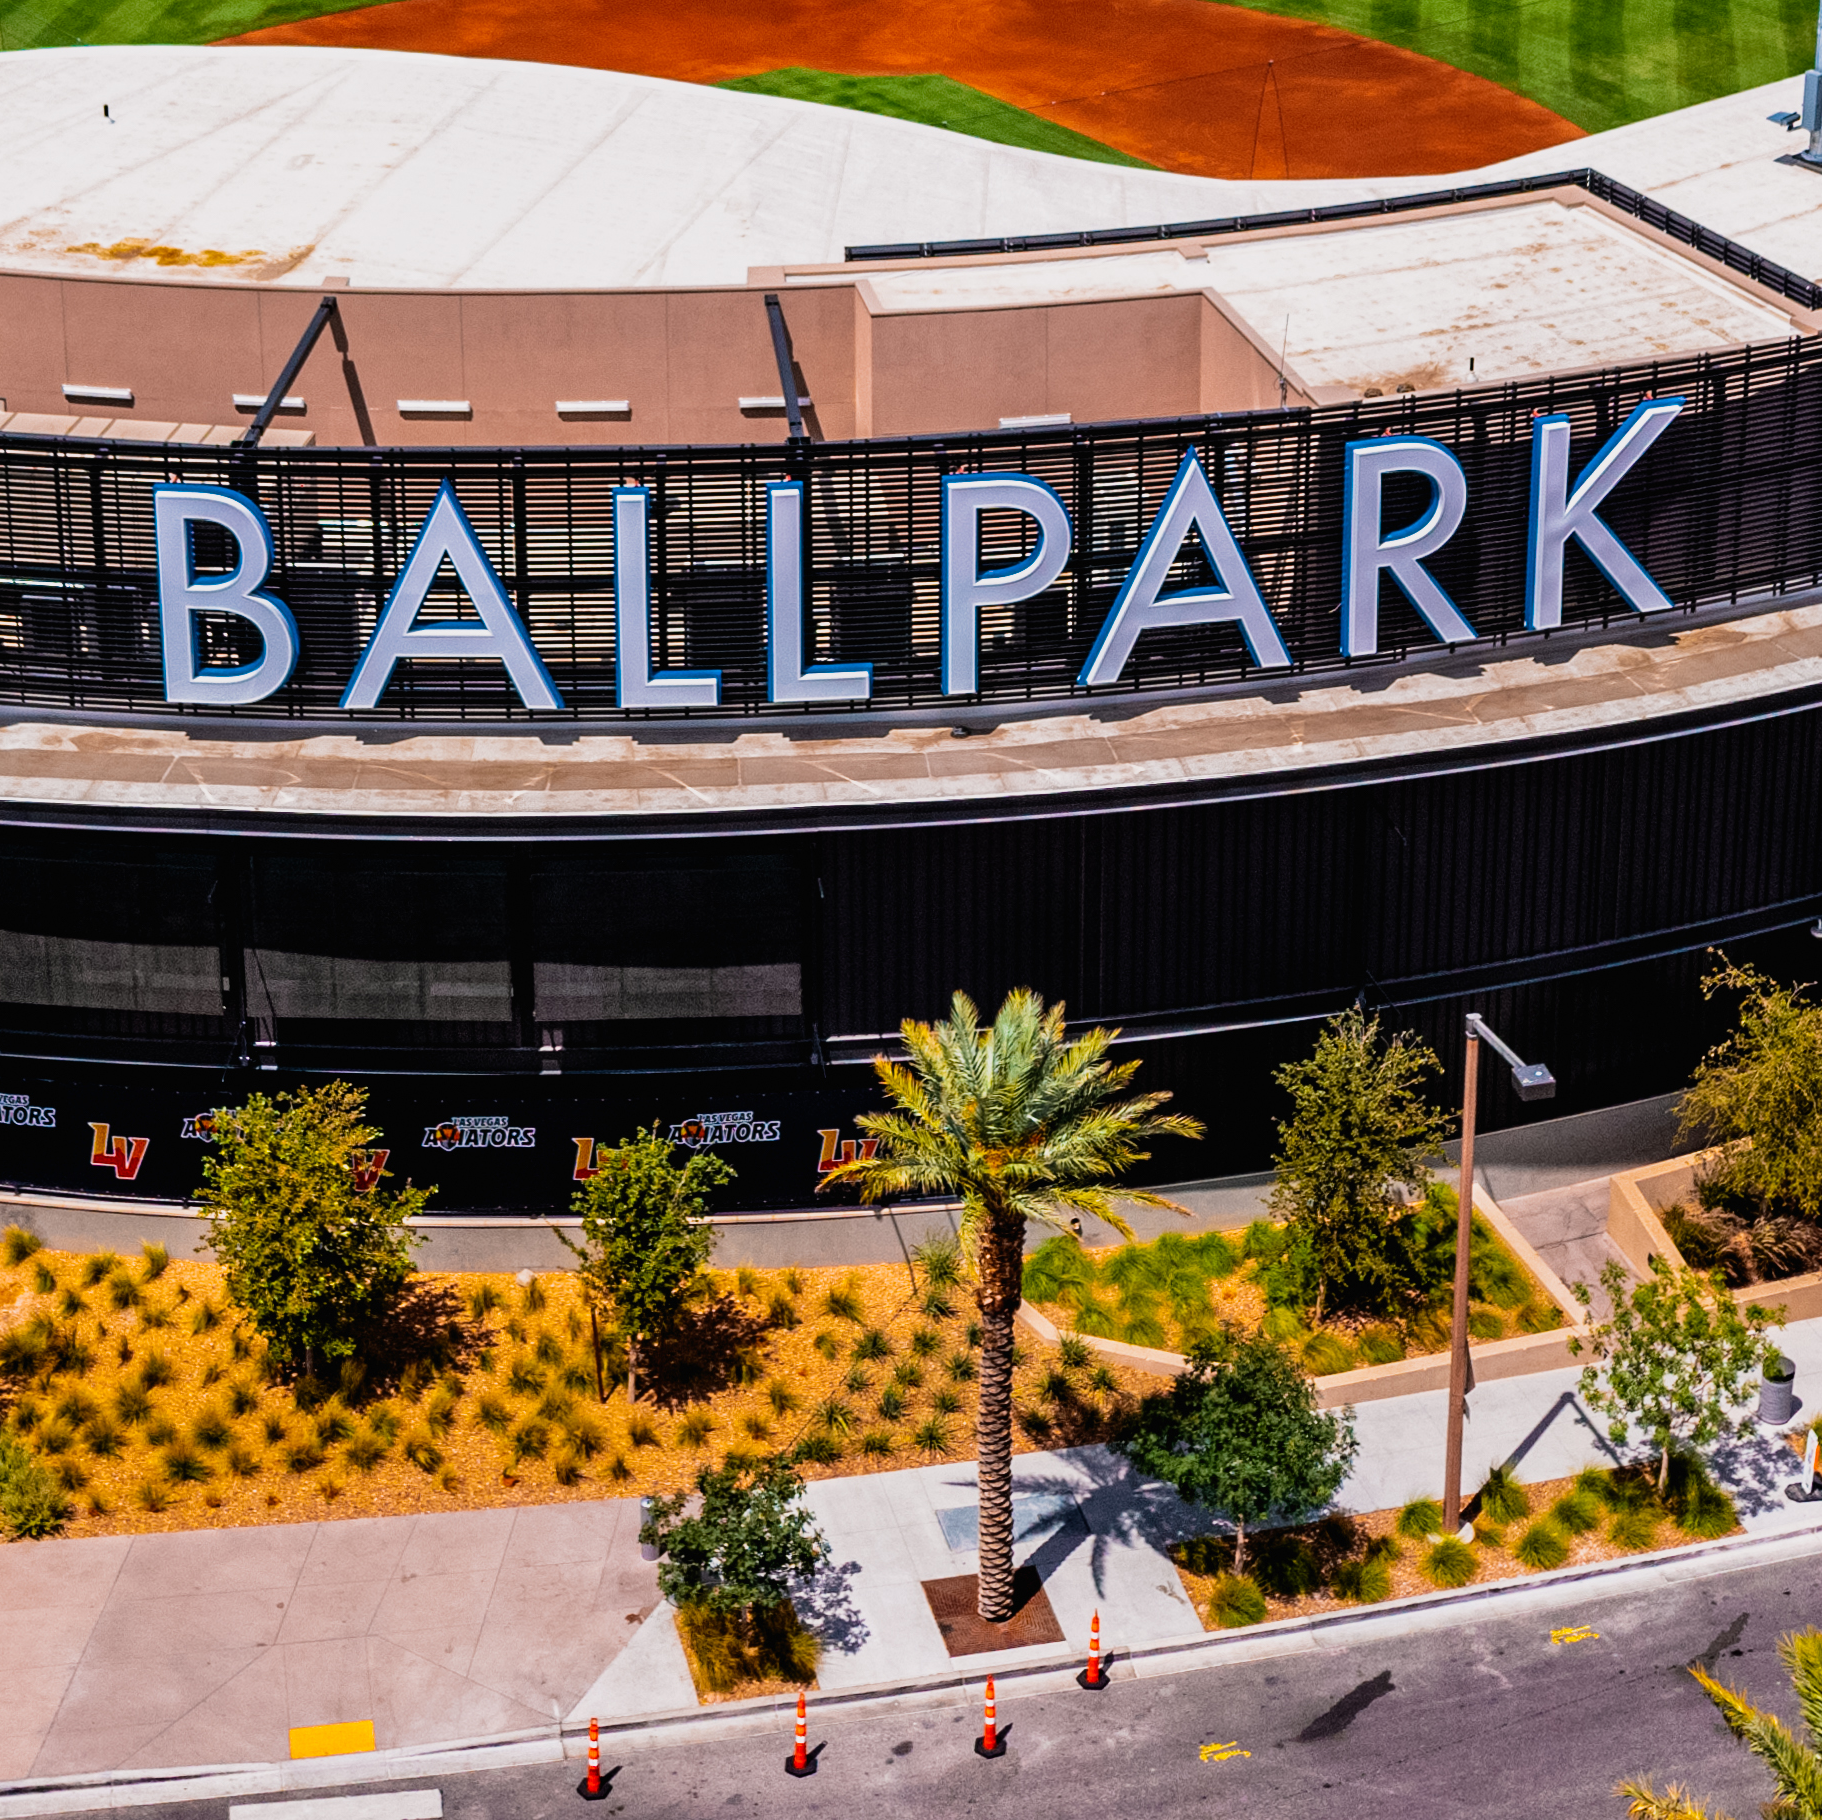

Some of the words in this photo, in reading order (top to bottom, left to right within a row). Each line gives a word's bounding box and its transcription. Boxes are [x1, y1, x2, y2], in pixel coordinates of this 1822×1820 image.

[153, 396, 1686, 711] BALLPARK
[452, 1117, 472, 1127] LAS
[474, 1116, 509, 1127] VEGAS
[697, 1113, 718, 1124] LAS
[720, 1111, 754, 1123] VEGAS
